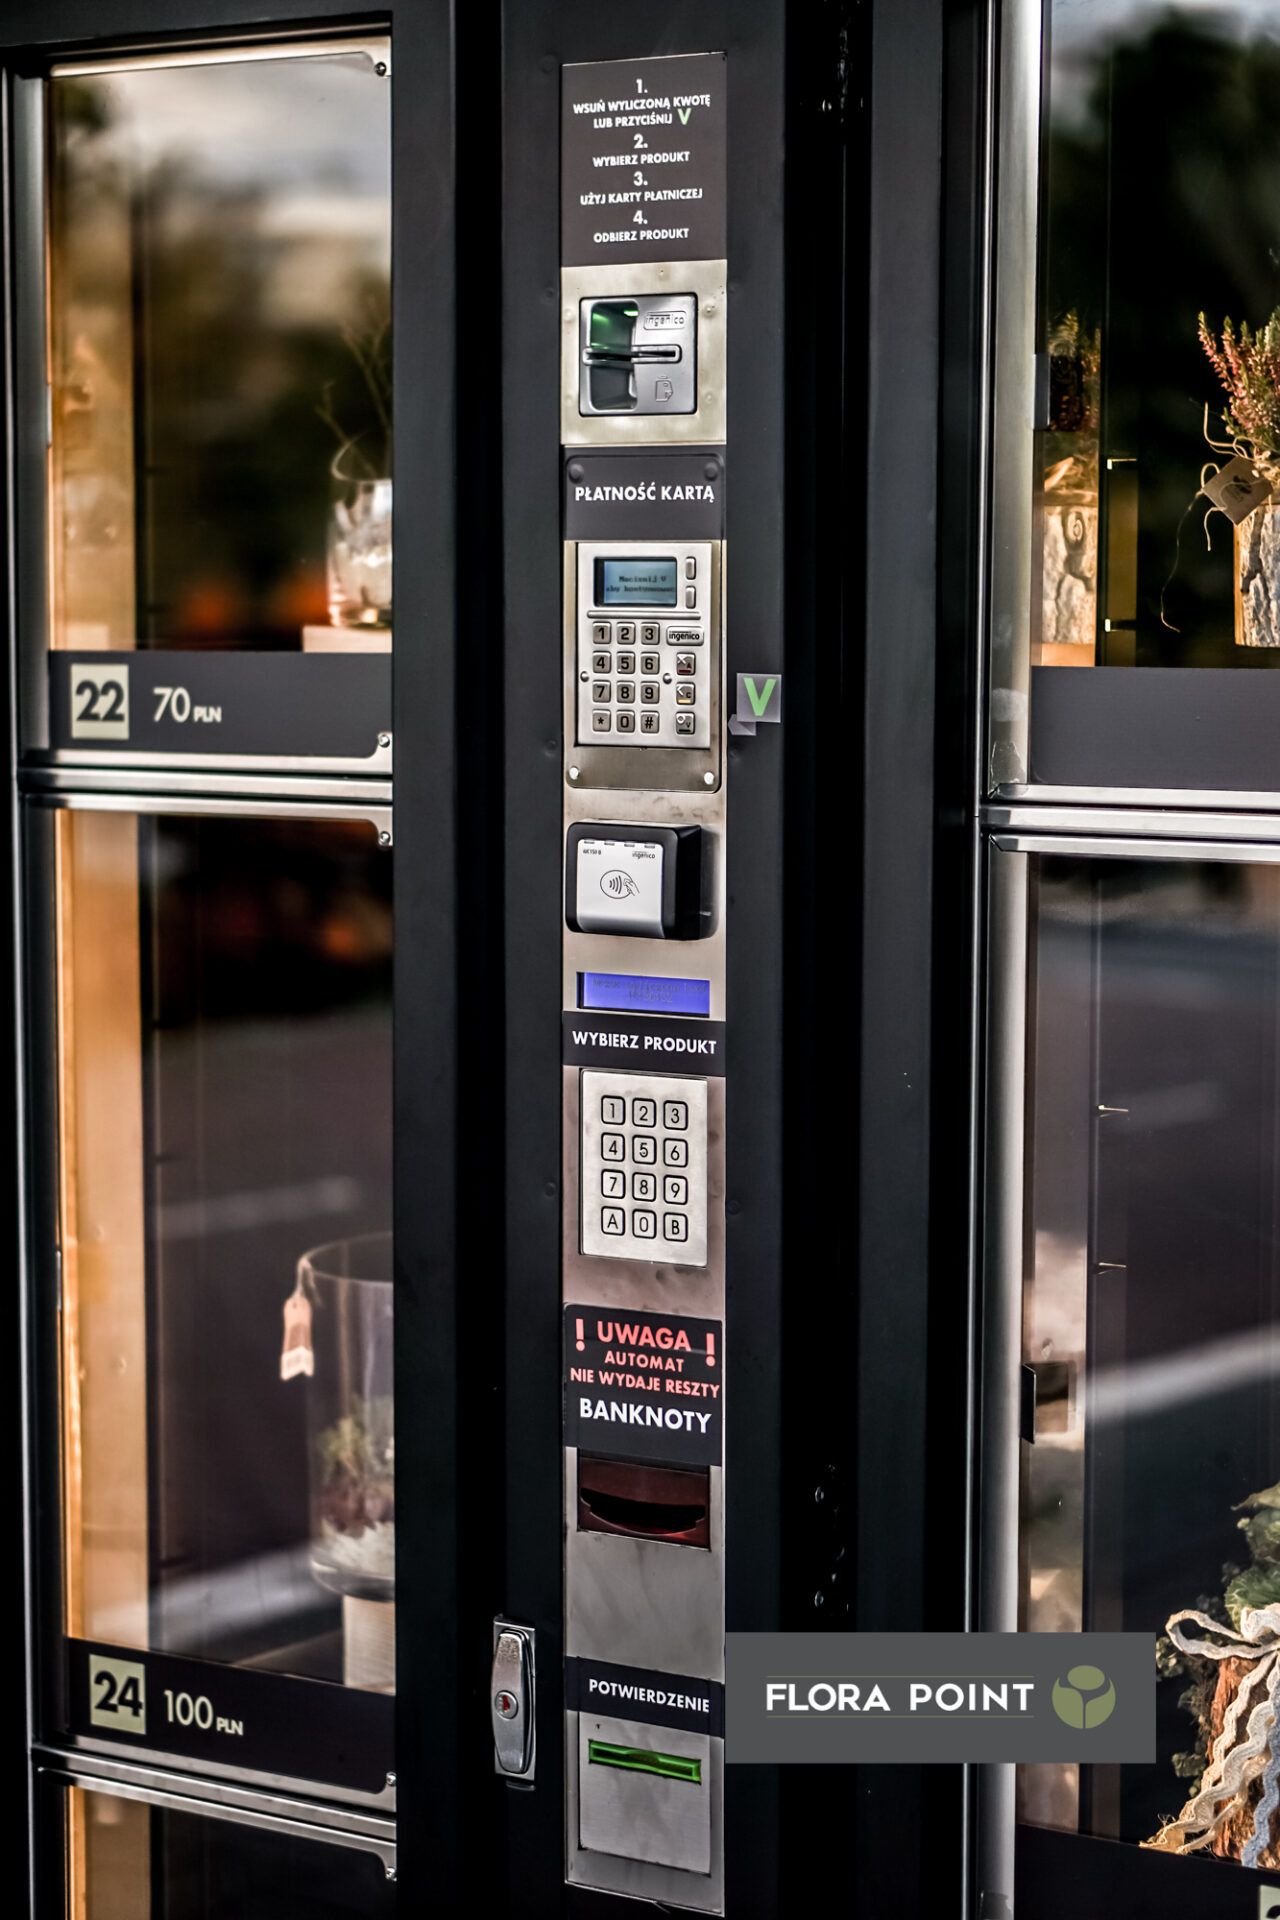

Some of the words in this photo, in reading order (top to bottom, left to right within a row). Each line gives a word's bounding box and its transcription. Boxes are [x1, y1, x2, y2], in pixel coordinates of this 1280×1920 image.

[636, 79, 648, 93] 1.
[573, 100, 605, 114] WSUŃ
[608, 98, 671, 112] WYLICZONĄ
[673, 95, 710, 107] KWOTĘ
[594, 118, 612, 128] LUB
[615, 112, 672, 127] PRZYCIŚNIJ
[677, 108, 691, 125] V
[633, 134, 648, 148] 2.
[593, 155, 638, 167] WYBIERZ
[641, 152, 690, 164] PRODUKT
[633, 171, 648, 186] 3.
[580, 192, 605, 205] UŻYJ
[608, 192, 641, 203] KARTY
[645, 189, 702, 201] PŁATNICZEJ
[633, 210, 648, 224] 4.
[594, 231, 638, 243] ODBIERZ
[640, 228, 689, 240] PRODUKT
[575, 482, 656, 500] PŁATNOŚĆ
[661, 485, 714, 502] KARTĄ
[598, 628, 605, 639] 1
[621, 628, 629, 639] 2
[645, 628, 653, 640] 3
[669, 631, 700, 643] ingenico
[596, 657, 605, 668] 4
[621, 657, 629, 669] 5
[645, 658, 653, 669] 6
[76, 680, 125, 722] 22
[597, 686, 605, 698] 7
[621, 687, 629, 699] 8
[645, 687, 653, 699] 9
[743, 677, 777, 716] V
[153, 687, 191, 722] 70
[194, 707, 222, 722] PLN
[621, 716, 629, 727] 0
[572, 1031, 638, 1048] WYBIERZ
[644, 1036, 716, 1054] PRODUKT
[610, 1103, 615, 1118] 1
[639, 1106, 648, 1121] 2
[671, 1108, 679, 1123] 3
[609, 1140, 617, 1155] 4
[640, 1143, 648, 1157] 5
[671, 1146, 679, 1160] 6
[609, 1177, 617, 1192] 7
[640, 1180, 648, 1195] 8
[671, 1183, 680, 1197] 9
[607, 1214, 618, 1229] A
[672, 1220, 679, 1234] B
[597, 1321, 691, 1351] UWAGA
[605, 1351, 684, 1372] AUTOMAT
[570, 1368, 594, 1382] NIE
[599, 1371, 660, 1391] WYDAJE
[666, 1379, 720, 1398] RESZTY
[580, 1398, 712, 1433] BANKNOTY
[94, 1671, 143, 1717] 24
[588, 1679, 710, 1713] POTWIERDZENIE
[164, 1690, 213, 1729] 100
[217, 1716, 243, 1736] PLN
